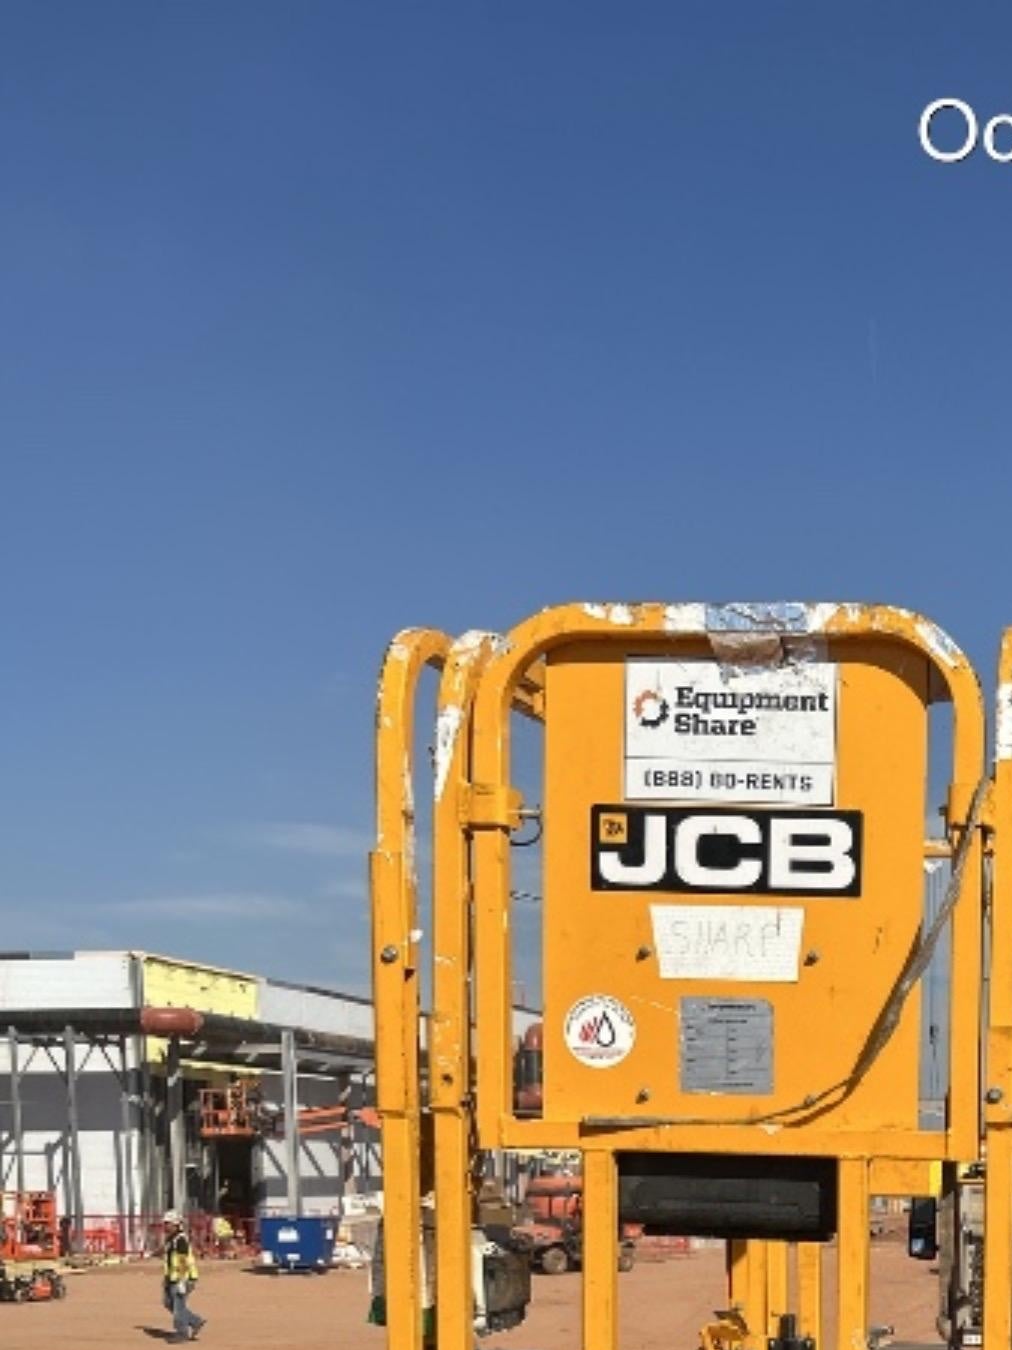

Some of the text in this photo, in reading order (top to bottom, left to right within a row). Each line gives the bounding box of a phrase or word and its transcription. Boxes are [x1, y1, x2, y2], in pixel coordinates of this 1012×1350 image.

[674, 686, 829, 714] Equipment
[674, 713, 756, 736] Share
[599, 814, 857, 890] JCB
